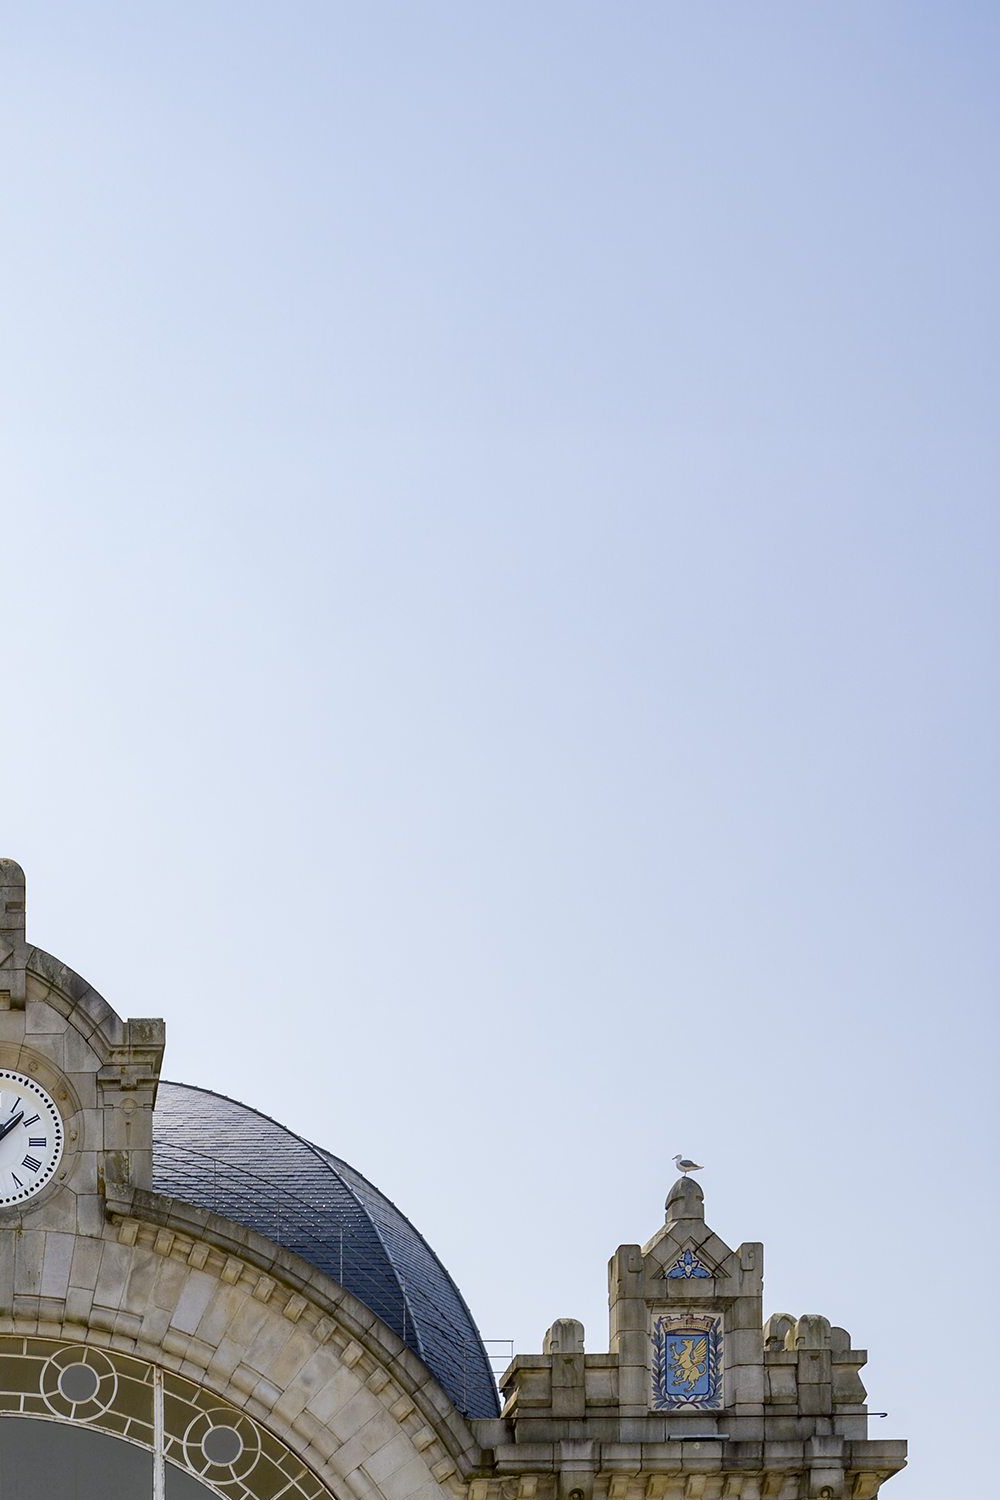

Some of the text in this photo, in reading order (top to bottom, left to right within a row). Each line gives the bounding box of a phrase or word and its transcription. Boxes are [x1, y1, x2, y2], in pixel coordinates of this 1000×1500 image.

[10, 1097, 22, 1113] I
[23, 1114, 40, 1127] II
[29, 1138, 46, 1147] III
[21, 1155, 42, 1173] IIII
[12, 1172, 23, 1189] V
